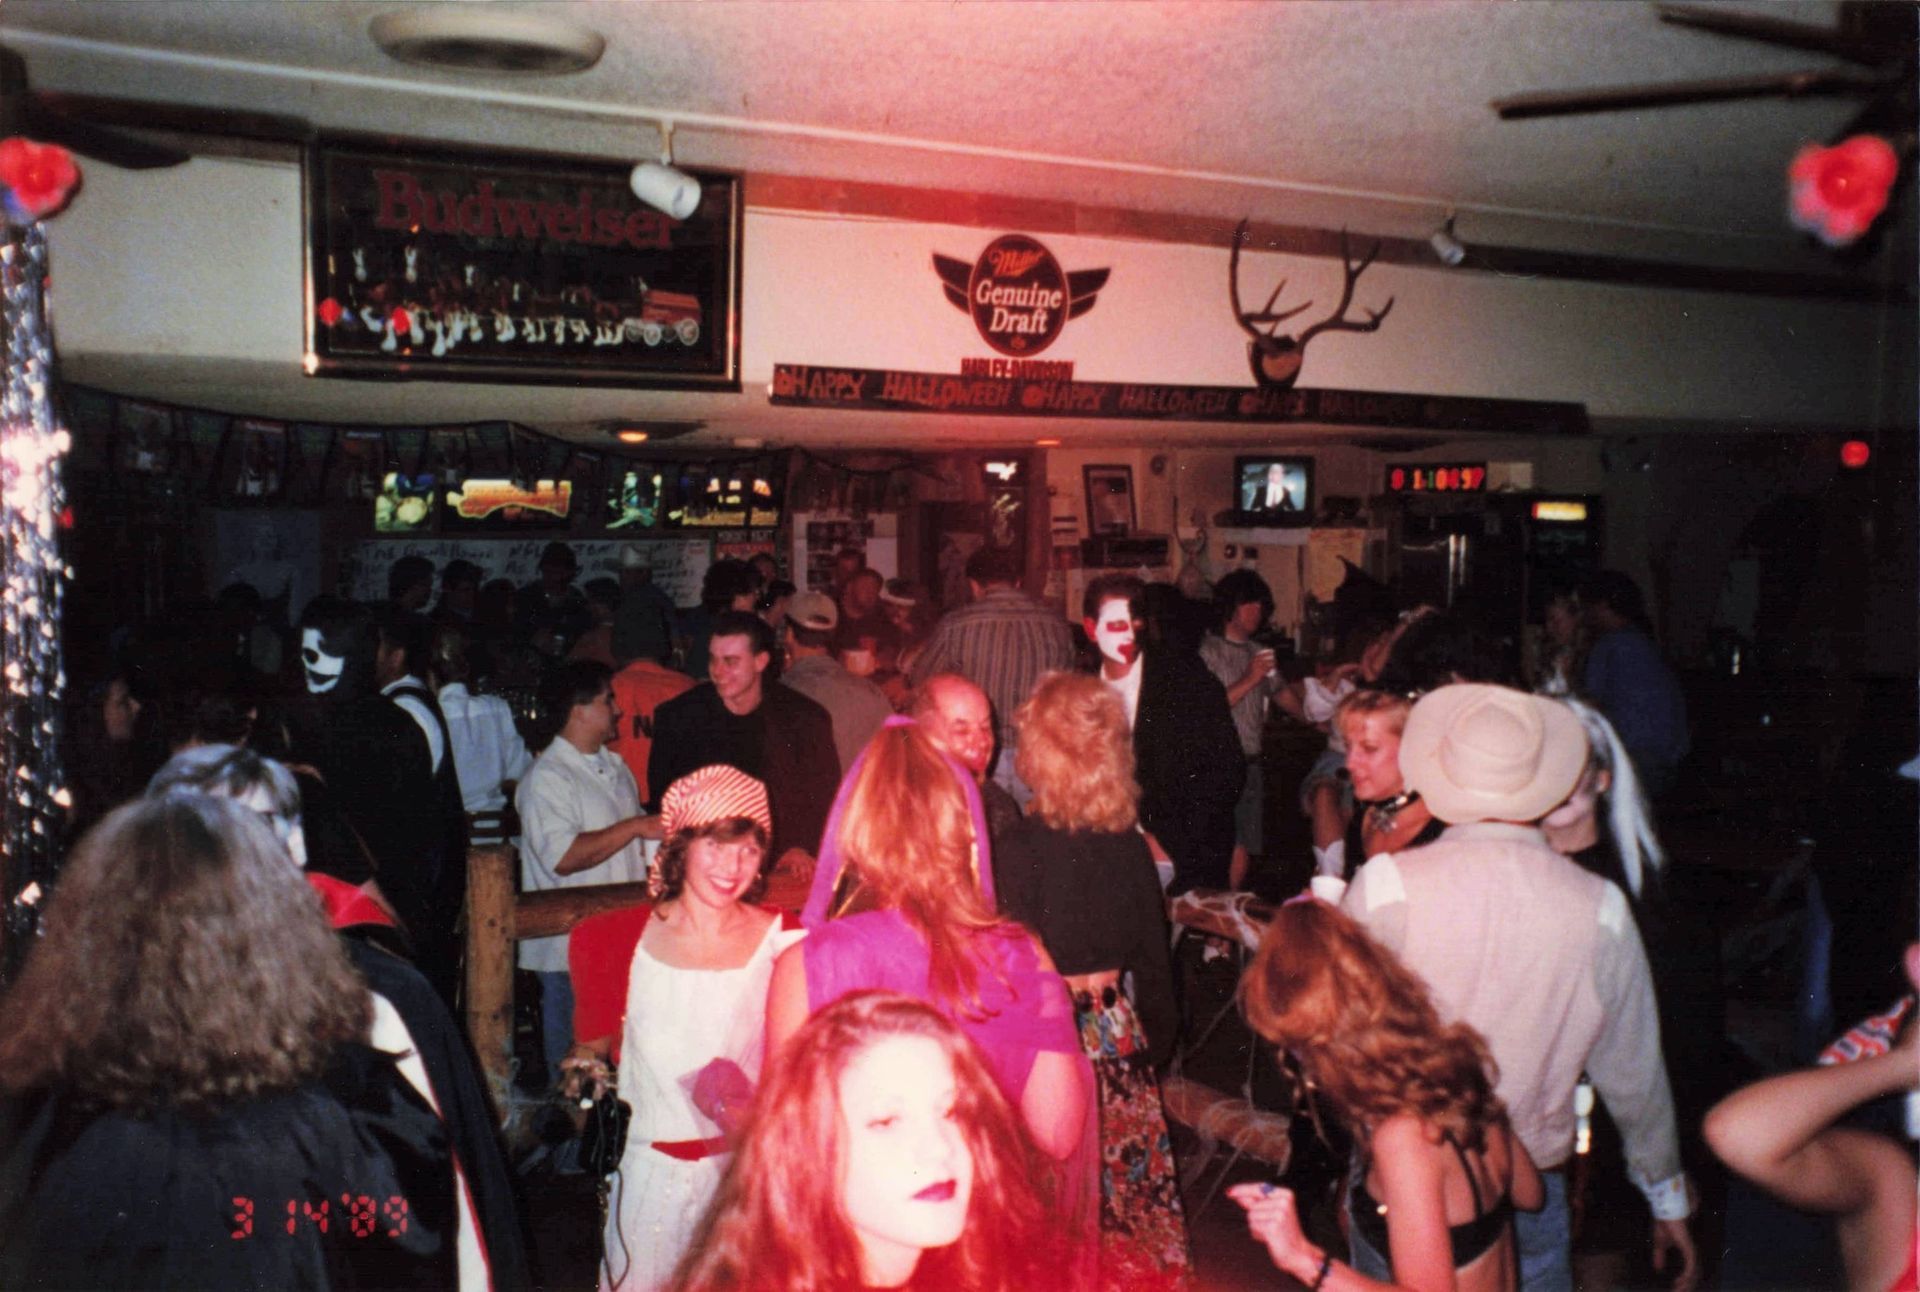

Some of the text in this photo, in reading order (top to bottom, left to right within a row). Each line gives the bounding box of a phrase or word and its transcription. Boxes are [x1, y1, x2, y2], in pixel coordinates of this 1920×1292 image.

[373, 168, 681, 249] Budweiser
[975, 278, 1063, 309] Genuine
[988, 308, 1049, 334] Draft
[790, 365, 866, 399] HAPPY
[882, 371, 1012, 407] HALLOWEEN
